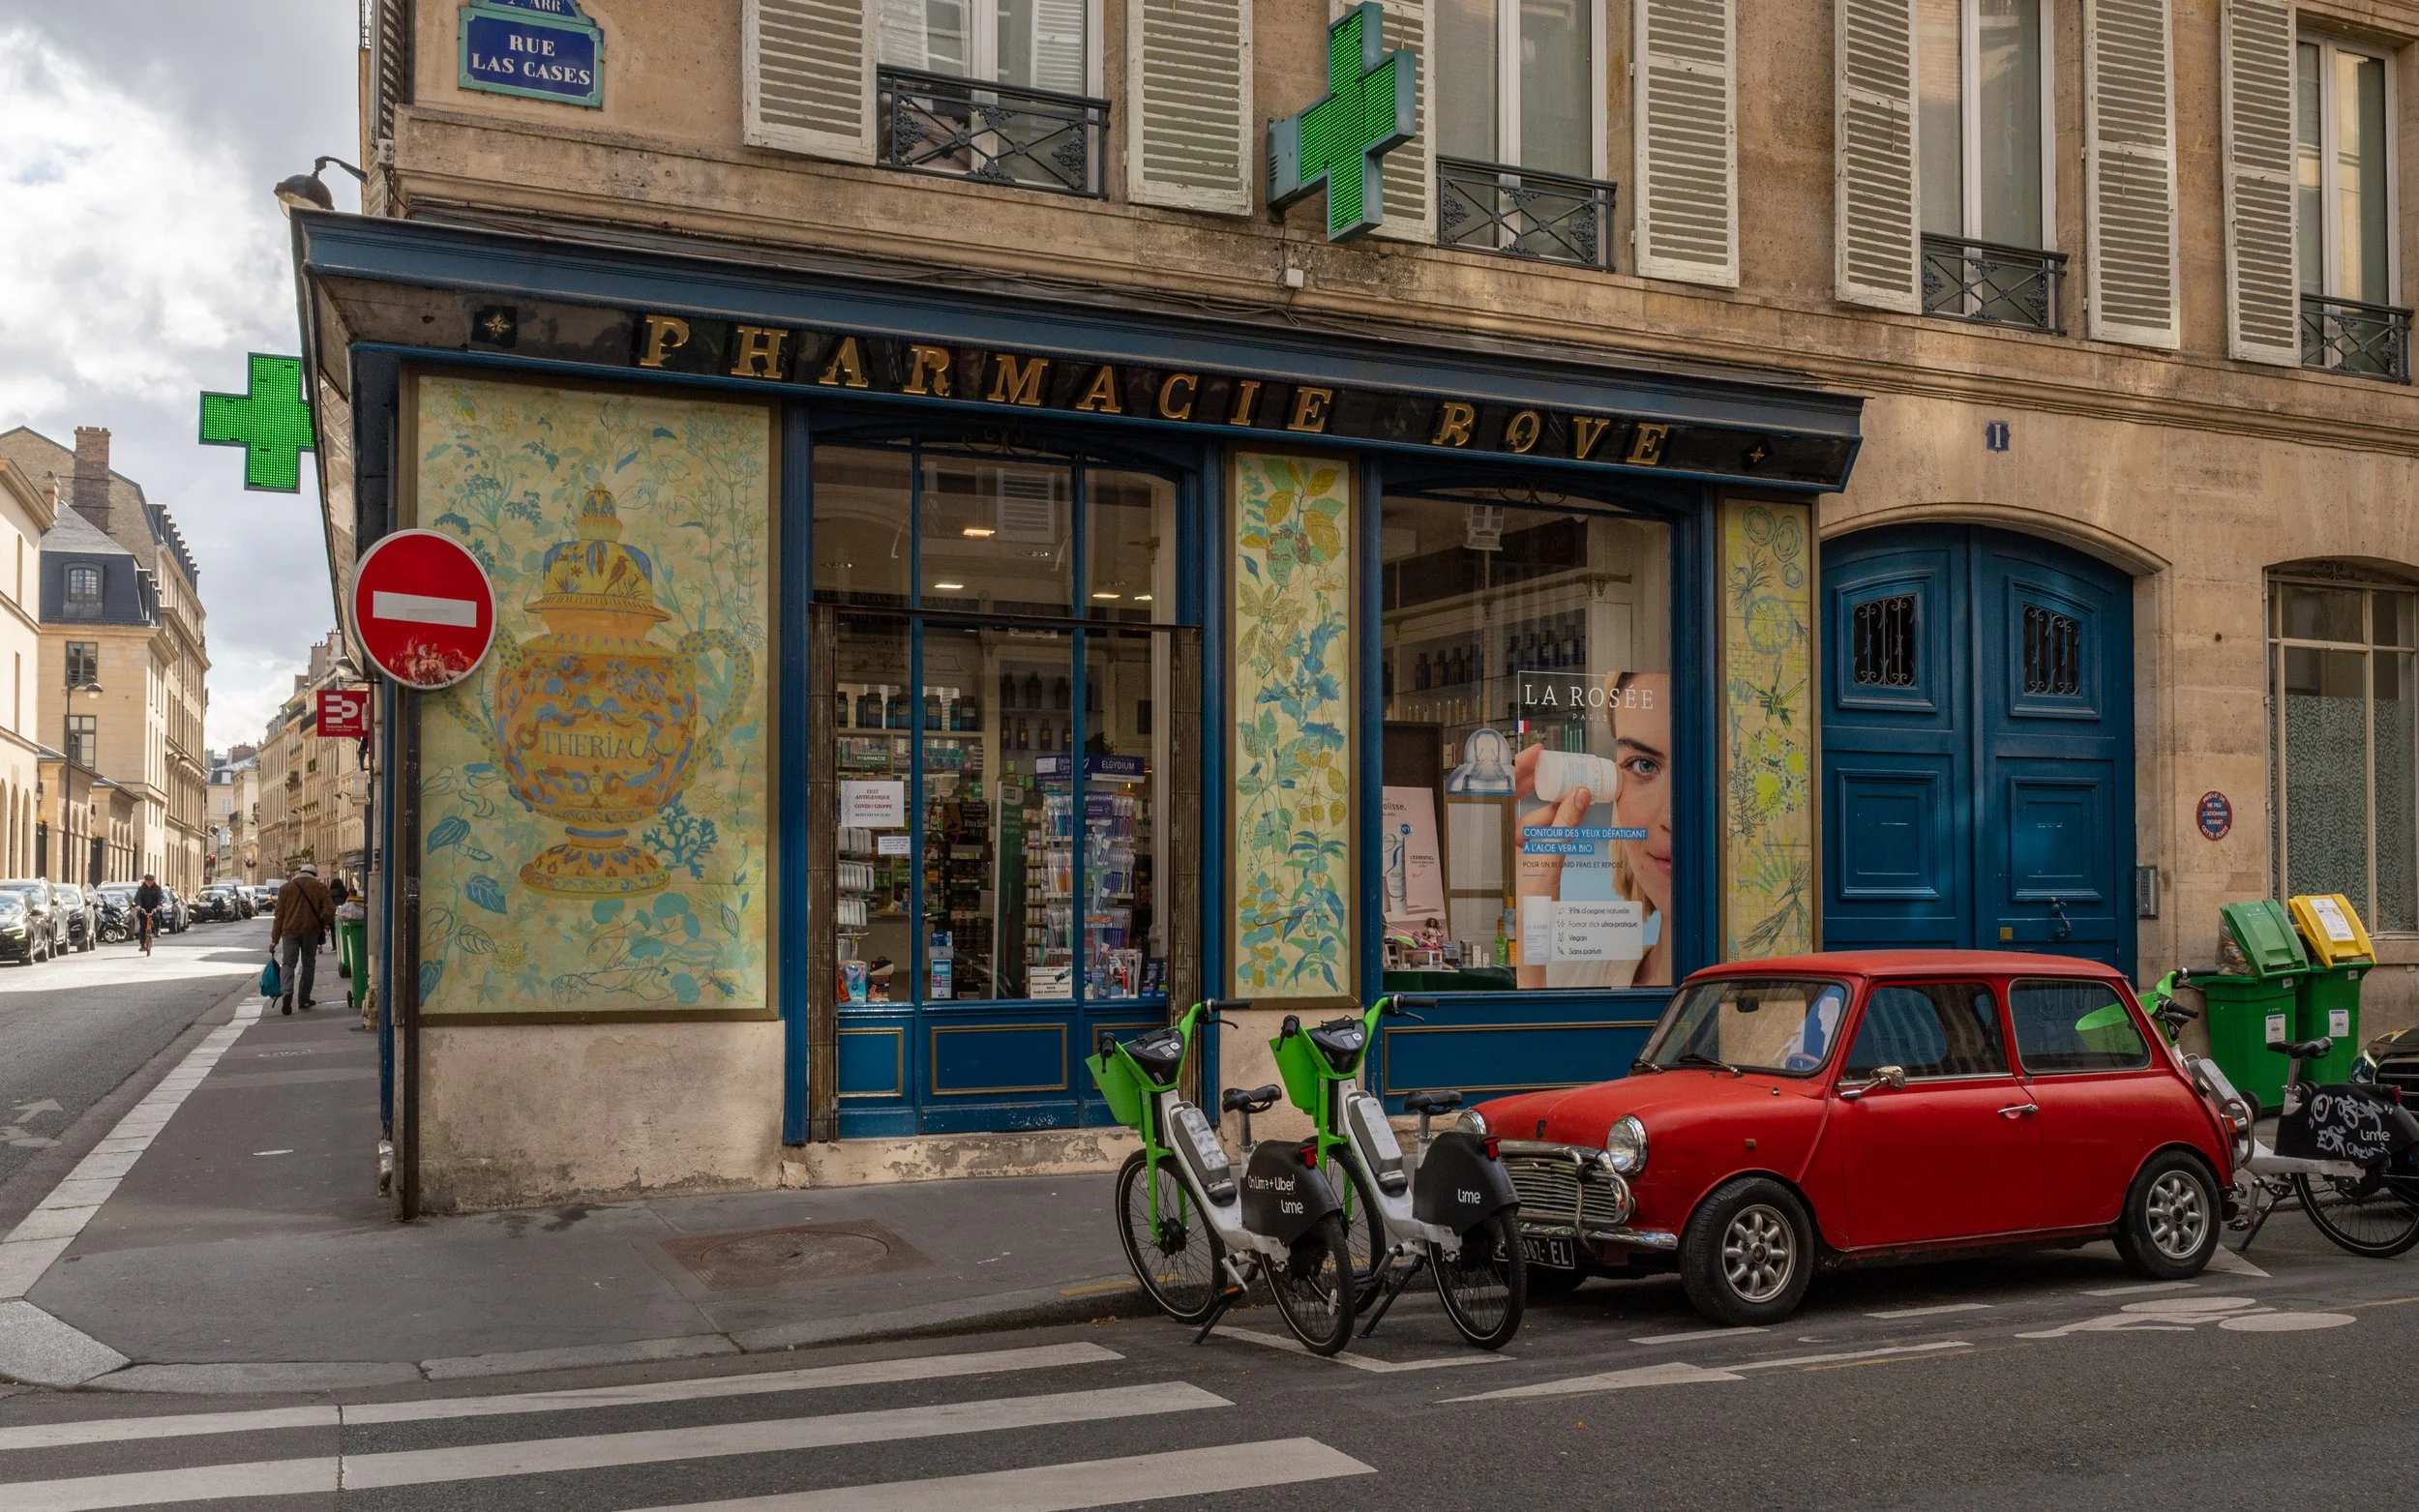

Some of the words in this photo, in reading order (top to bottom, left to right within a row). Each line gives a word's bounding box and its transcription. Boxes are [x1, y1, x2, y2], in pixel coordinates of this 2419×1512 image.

[509, 34, 555, 57] RUE
[472, 53, 515, 74] LAS
[523, 61, 591, 85] CASES
[640, 314, 1332, 433] PHARMACIE
[1432, 402, 1674, 465] BOVE
[1524, 684, 1559, 706] LA
[1569, 684, 1654, 709] ROSÉE
[1572, 713, 1608, 722] PARIS
[1101, 759, 1135, 771] ELGYDIUM
[1523, 827, 1563, 838] CONTOUR
[1565, 828, 1579, 838] DES
[1581, 829, 1601, 838] YEUX
[1601, 827, 1647, 839] DÉFATIGANT
[1524, 843, 1530, 852] À
[1558, 844, 1578, 852] VERA
[1600, 921, 1637, 930] ultra-pratique
[2360, 1129, 2392, 1141] Lime
[1457, 1188, 1481, 1204] Lime
[1280, 1199, 1304, 1214] Lime
